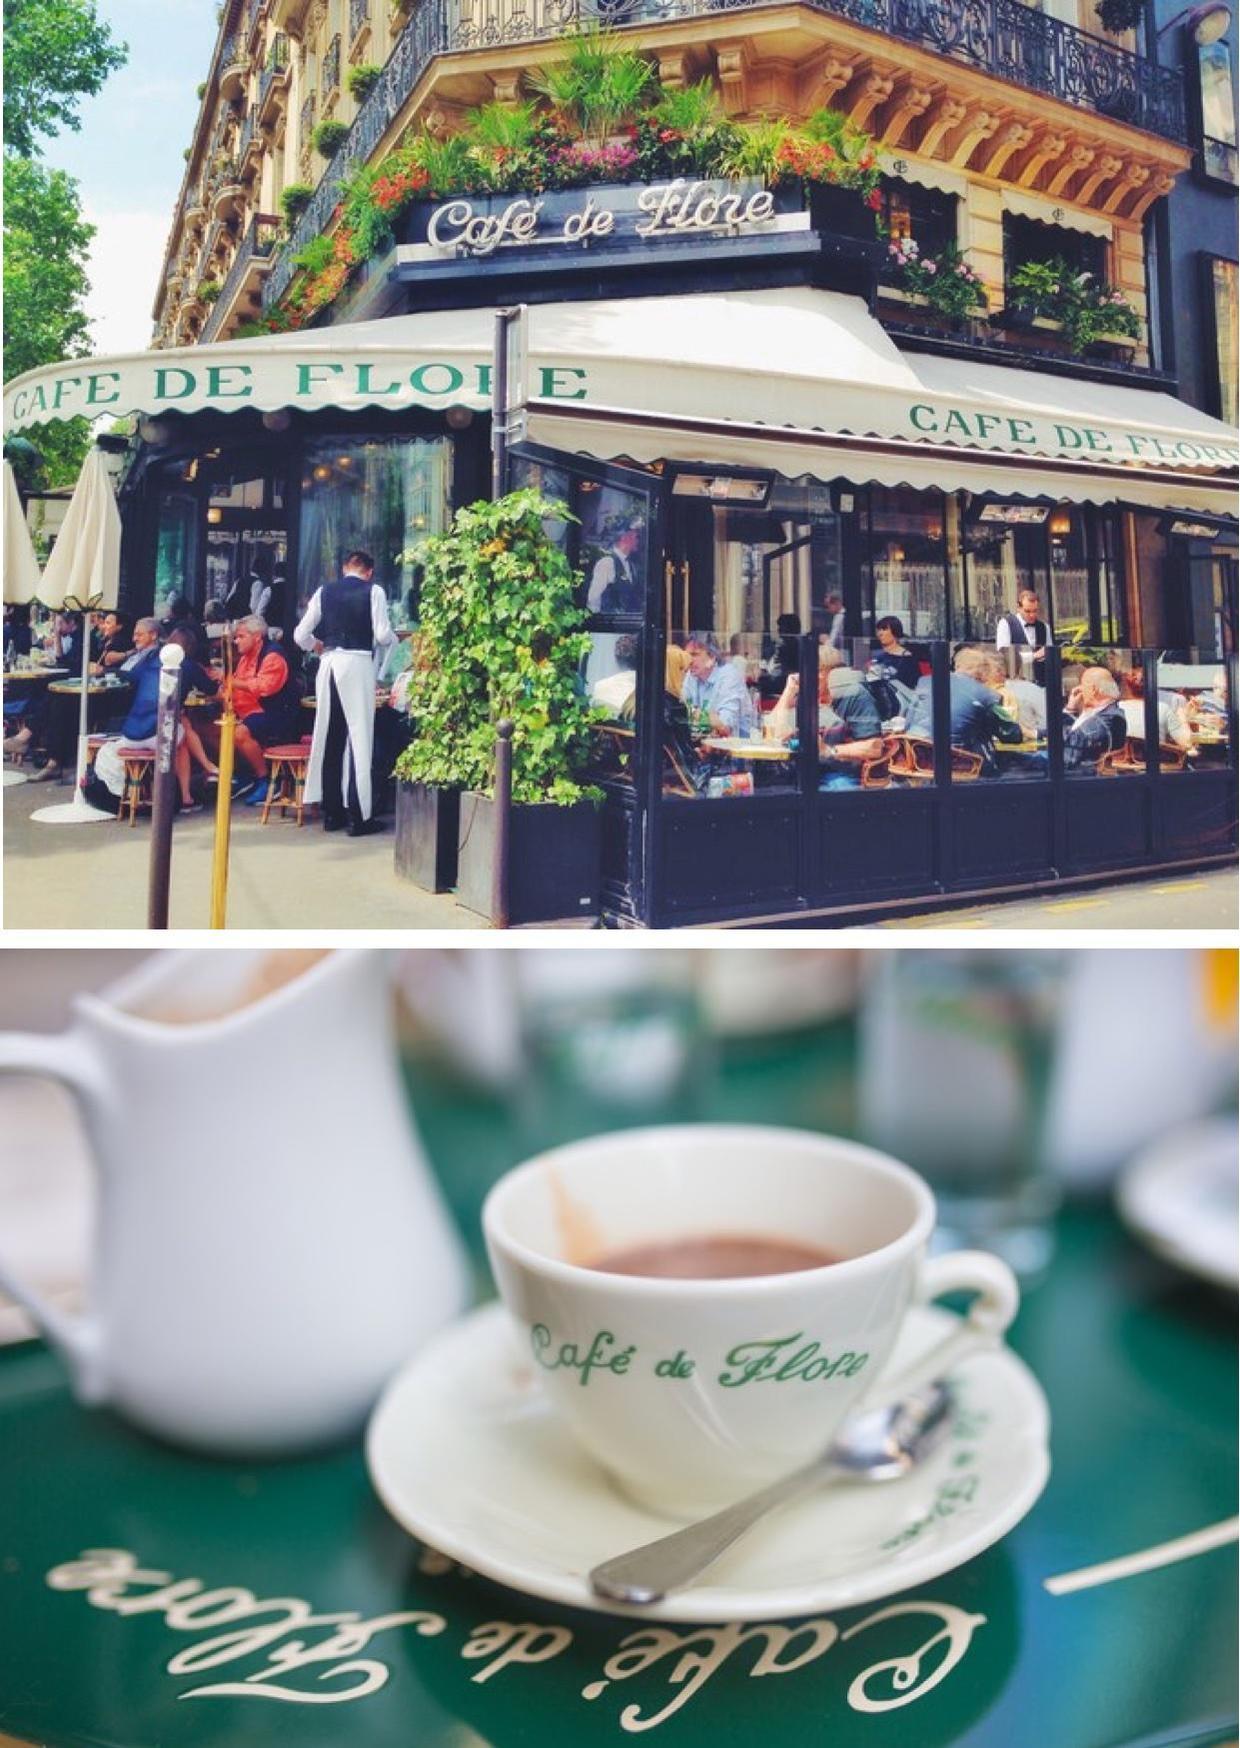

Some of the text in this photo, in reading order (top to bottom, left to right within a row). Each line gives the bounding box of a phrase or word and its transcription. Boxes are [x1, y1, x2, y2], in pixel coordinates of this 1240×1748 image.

[427, 179, 775, 256] Café de Flore
[14, 371, 120, 420] CAFE
[153, 366, 253, 400] DE
[909, 403, 1036, 444] CAFE
[1053, 423, 1113, 452] DE
[531, 1323, 869, 1388] Café de Flore
[46, 1548, 988, 1733] Café de Flore
